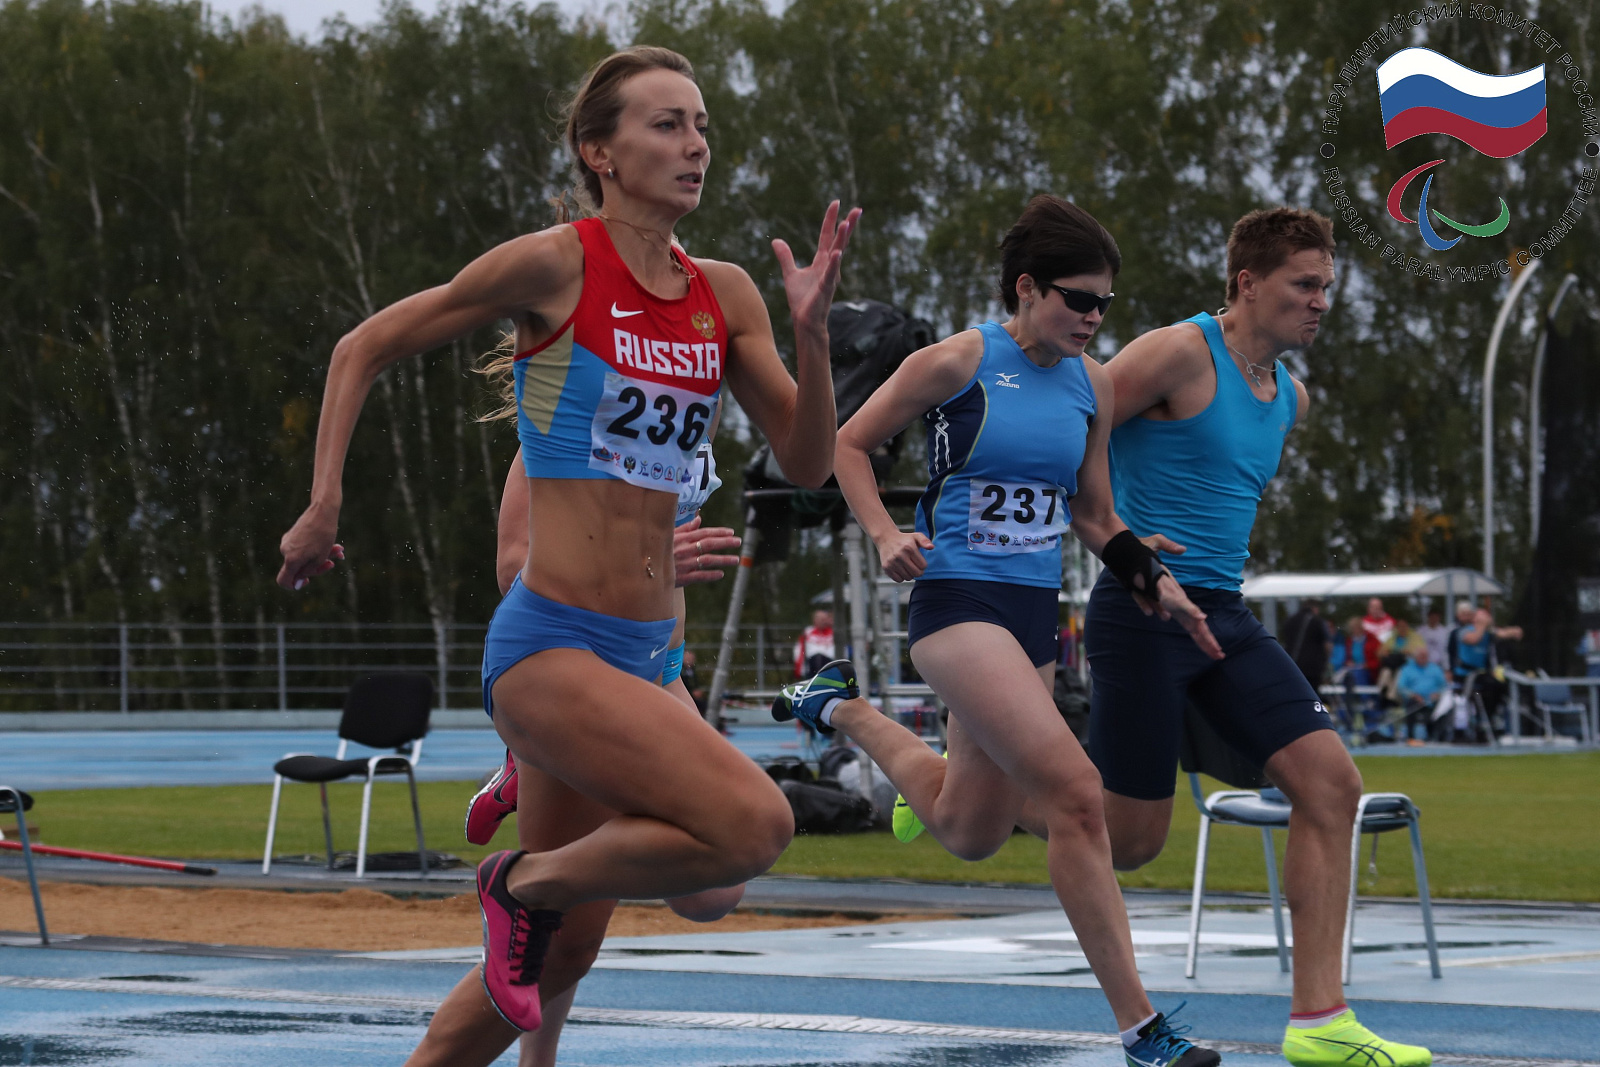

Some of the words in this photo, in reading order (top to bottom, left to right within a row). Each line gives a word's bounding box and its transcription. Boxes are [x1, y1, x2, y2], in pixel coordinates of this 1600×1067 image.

[613, 328, 721, 380] RUSSIA
[606, 386, 711, 452] 236
[980, 484, 1058, 526] 237
